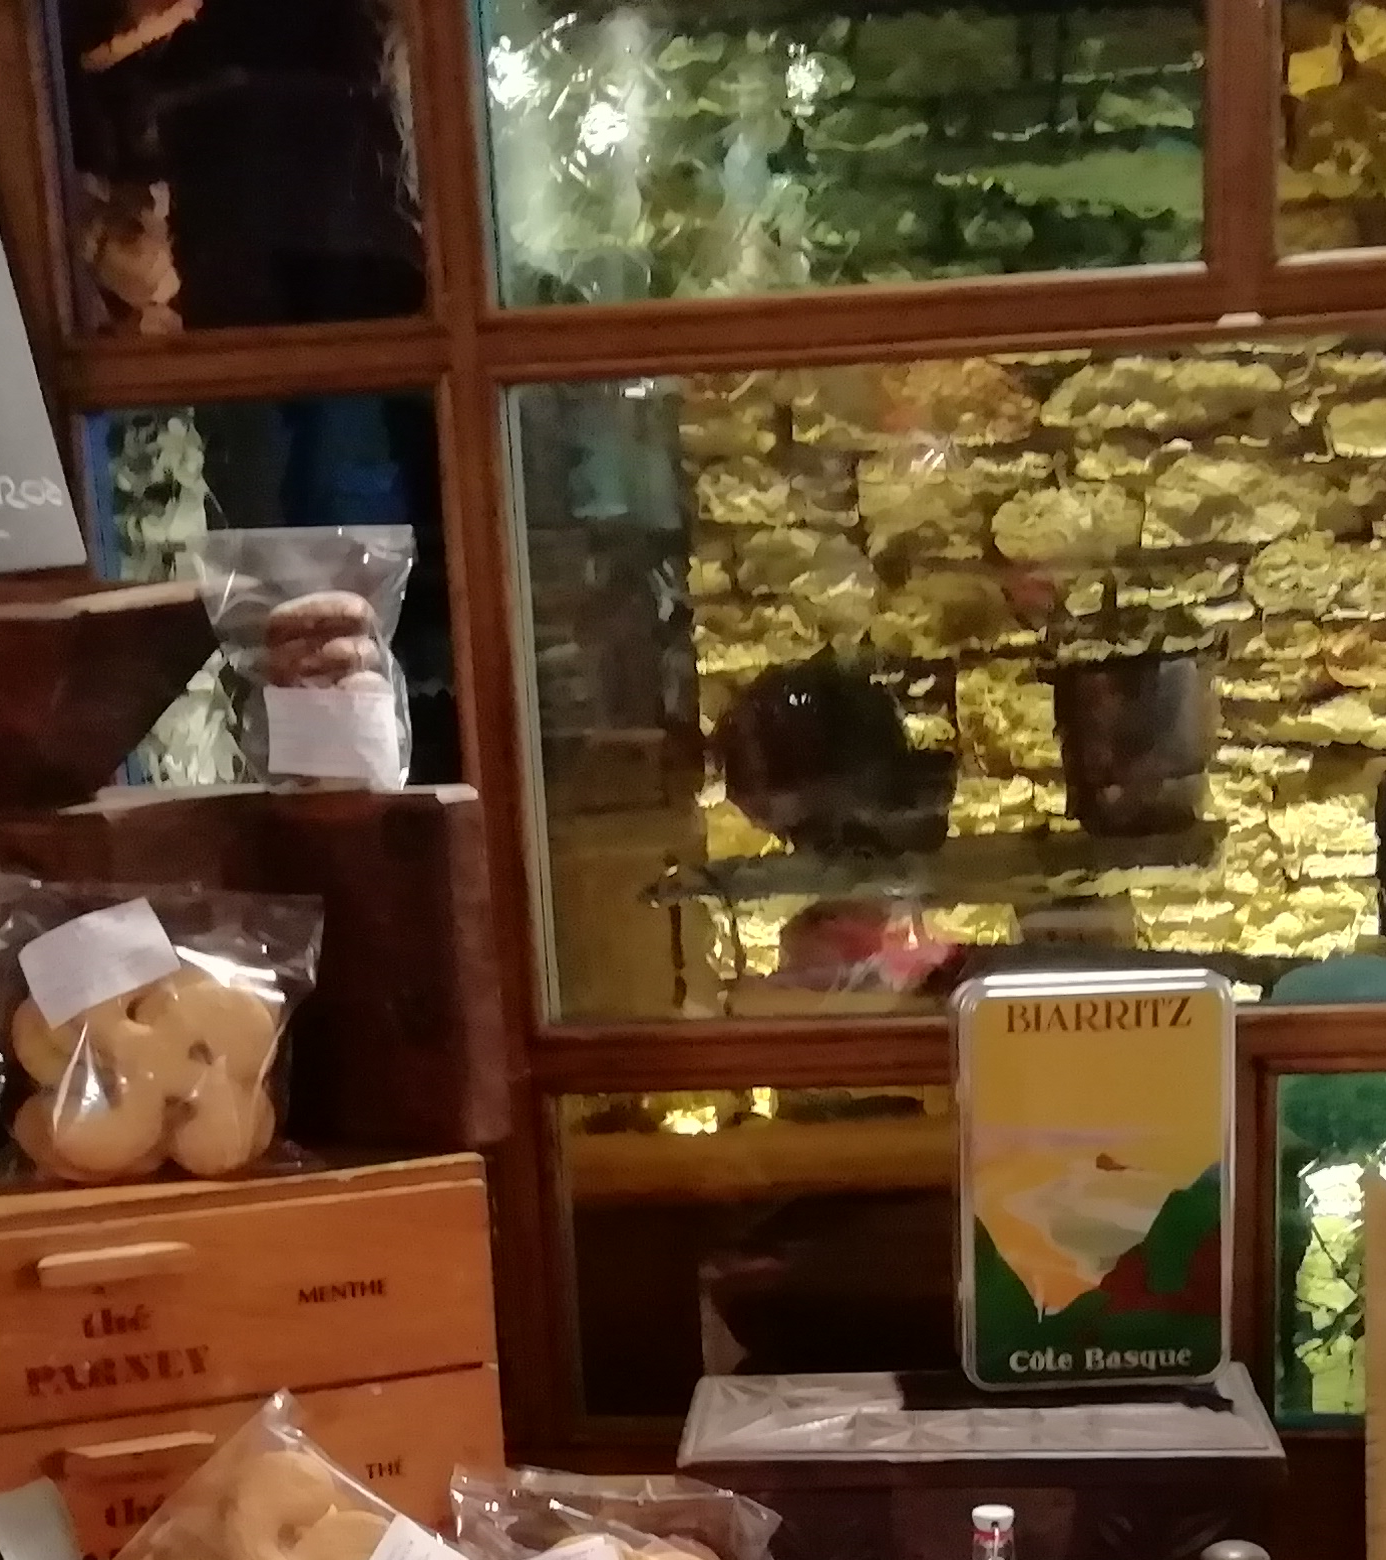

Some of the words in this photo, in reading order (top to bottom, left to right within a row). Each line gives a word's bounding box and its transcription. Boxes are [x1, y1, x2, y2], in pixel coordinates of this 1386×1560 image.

[1006, 996, 1193, 1034] BIARRITZ
[298, 1278, 387, 1305] MENTHE
[1085, 1346, 1193, 1374] Basque
